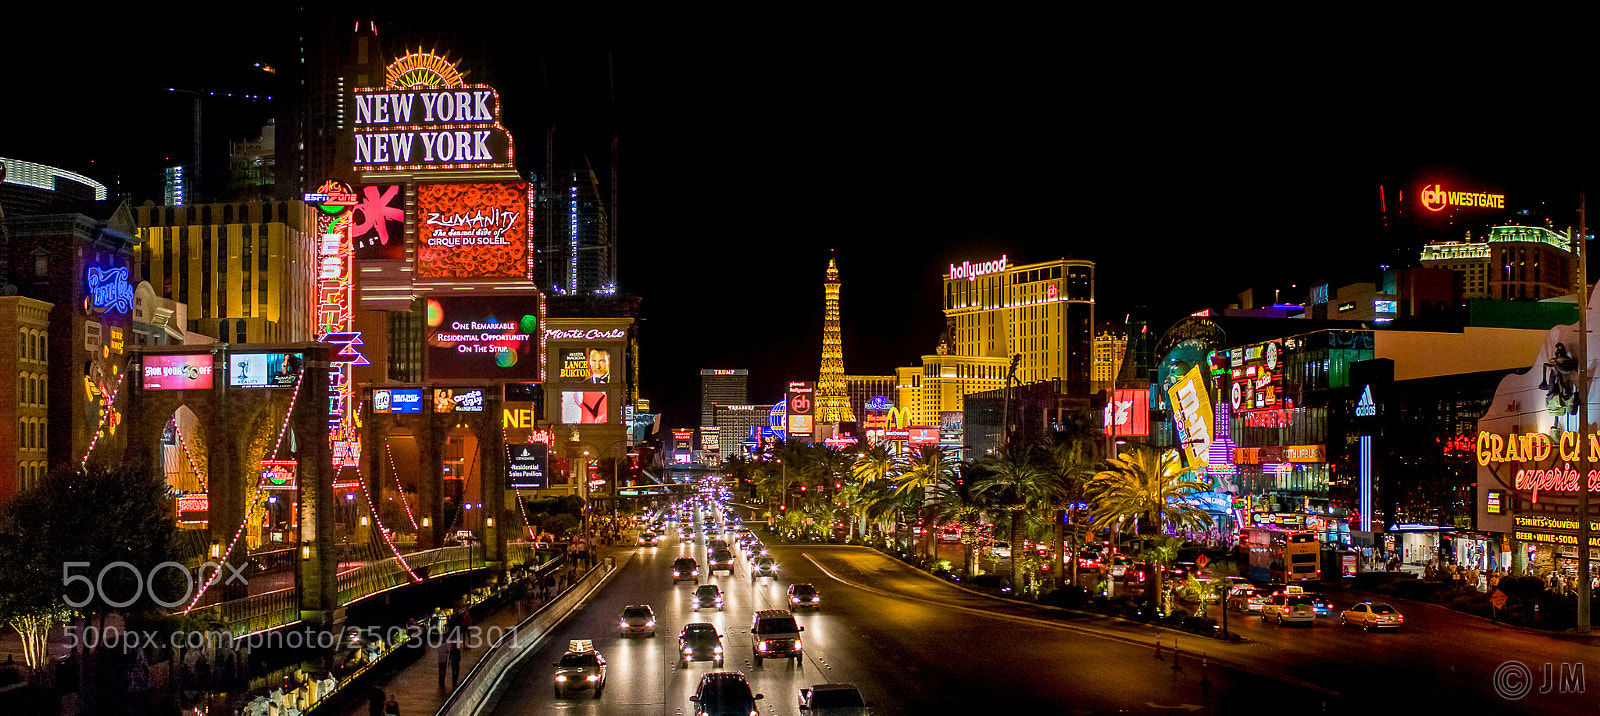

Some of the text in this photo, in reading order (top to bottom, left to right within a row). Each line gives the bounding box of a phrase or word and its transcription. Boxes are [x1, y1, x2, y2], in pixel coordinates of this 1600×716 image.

[354, 91, 493, 124] NEW YORK
[354, 131, 493, 164] NEW YORK
[1447, 191, 1505, 209] WESTGATE
[432, 229, 448, 237] The
[427, 238, 461, 248] CIRQUE
[462, 238, 475, 246] DU
[950, 254, 1007, 282] hollywood
[544, 328, 626, 340] Monte Carlo
[564, 361, 588, 369] LANCE
[560, 369, 591, 378] BURTON
[1355, 404, 1376, 416] adidas
[1477, 431, 1551, 466] GRAND
[1515, 517, 1545, 528] T-SHIRTS
[1515, 532, 1533, 541] BEER
[1536, 533, 1556, 543] WINE
[1558, 535, 1579, 545] SODA
